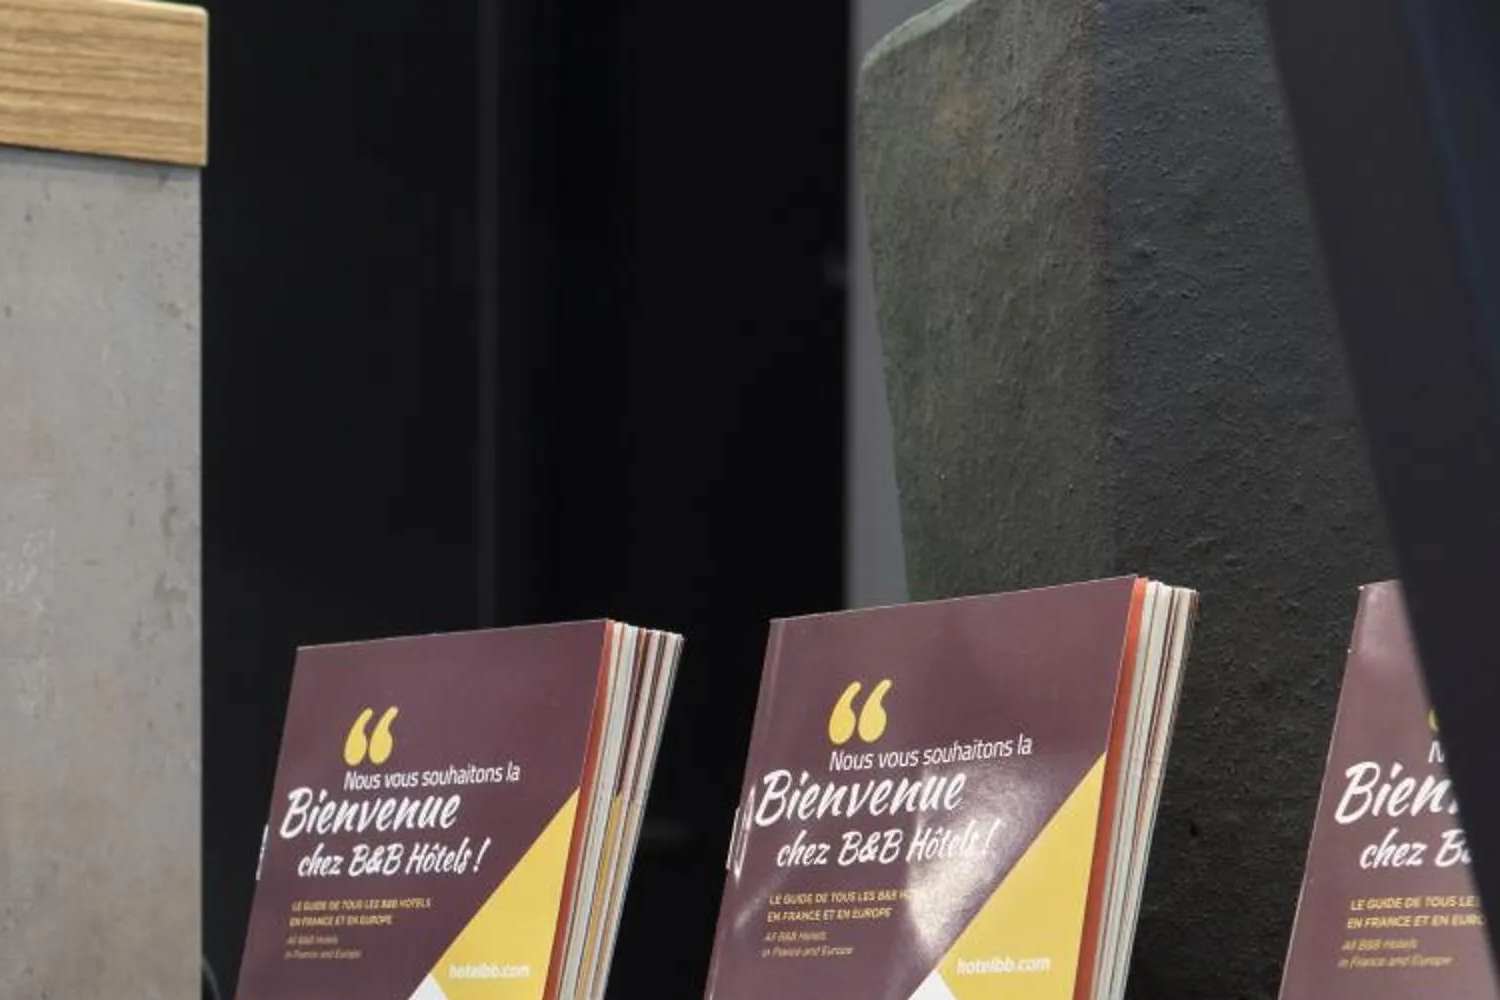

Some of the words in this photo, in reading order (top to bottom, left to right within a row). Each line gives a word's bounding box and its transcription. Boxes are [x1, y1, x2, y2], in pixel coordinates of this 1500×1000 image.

[829, 750, 874, 771] Nous
[878, 750, 919, 769] vous
[922, 739, 1014, 766] souhaitons
[1017, 733, 1033, 756] la
[344, 771, 380, 790] Nous
[385, 770, 419, 789] vous
[421, 764, 502, 788] souhaitons
[505, 761, 521, 783] la
[1334, 761, 1459, 825] Bien
[279, 786, 461, 840] Bienvenue
[755, 768, 967, 827] Bienvenue
[298, 843, 344, 877] chez
[348, 840, 404, 877] B&B
[776, 829, 831, 868] chez
[837, 828, 904, 867] B&B
[1359, 827, 1429, 870] chez
[782, 909, 821, 922] FRANCE
[851, 907, 892, 919] EUROPE
[1347, 916, 1363, 929] EN
[1364, 914, 1411, 928] FRANCE
[1413, 914, 1430, 927] ET
[1431, 913, 1449, 927] EN
[1350, 899, 1365, 911] LE
[1366, 897, 1403, 910] GUIDE
[1404, 896, 1421, 908] DE
[1425, 895, 1458, 908] TOUS
